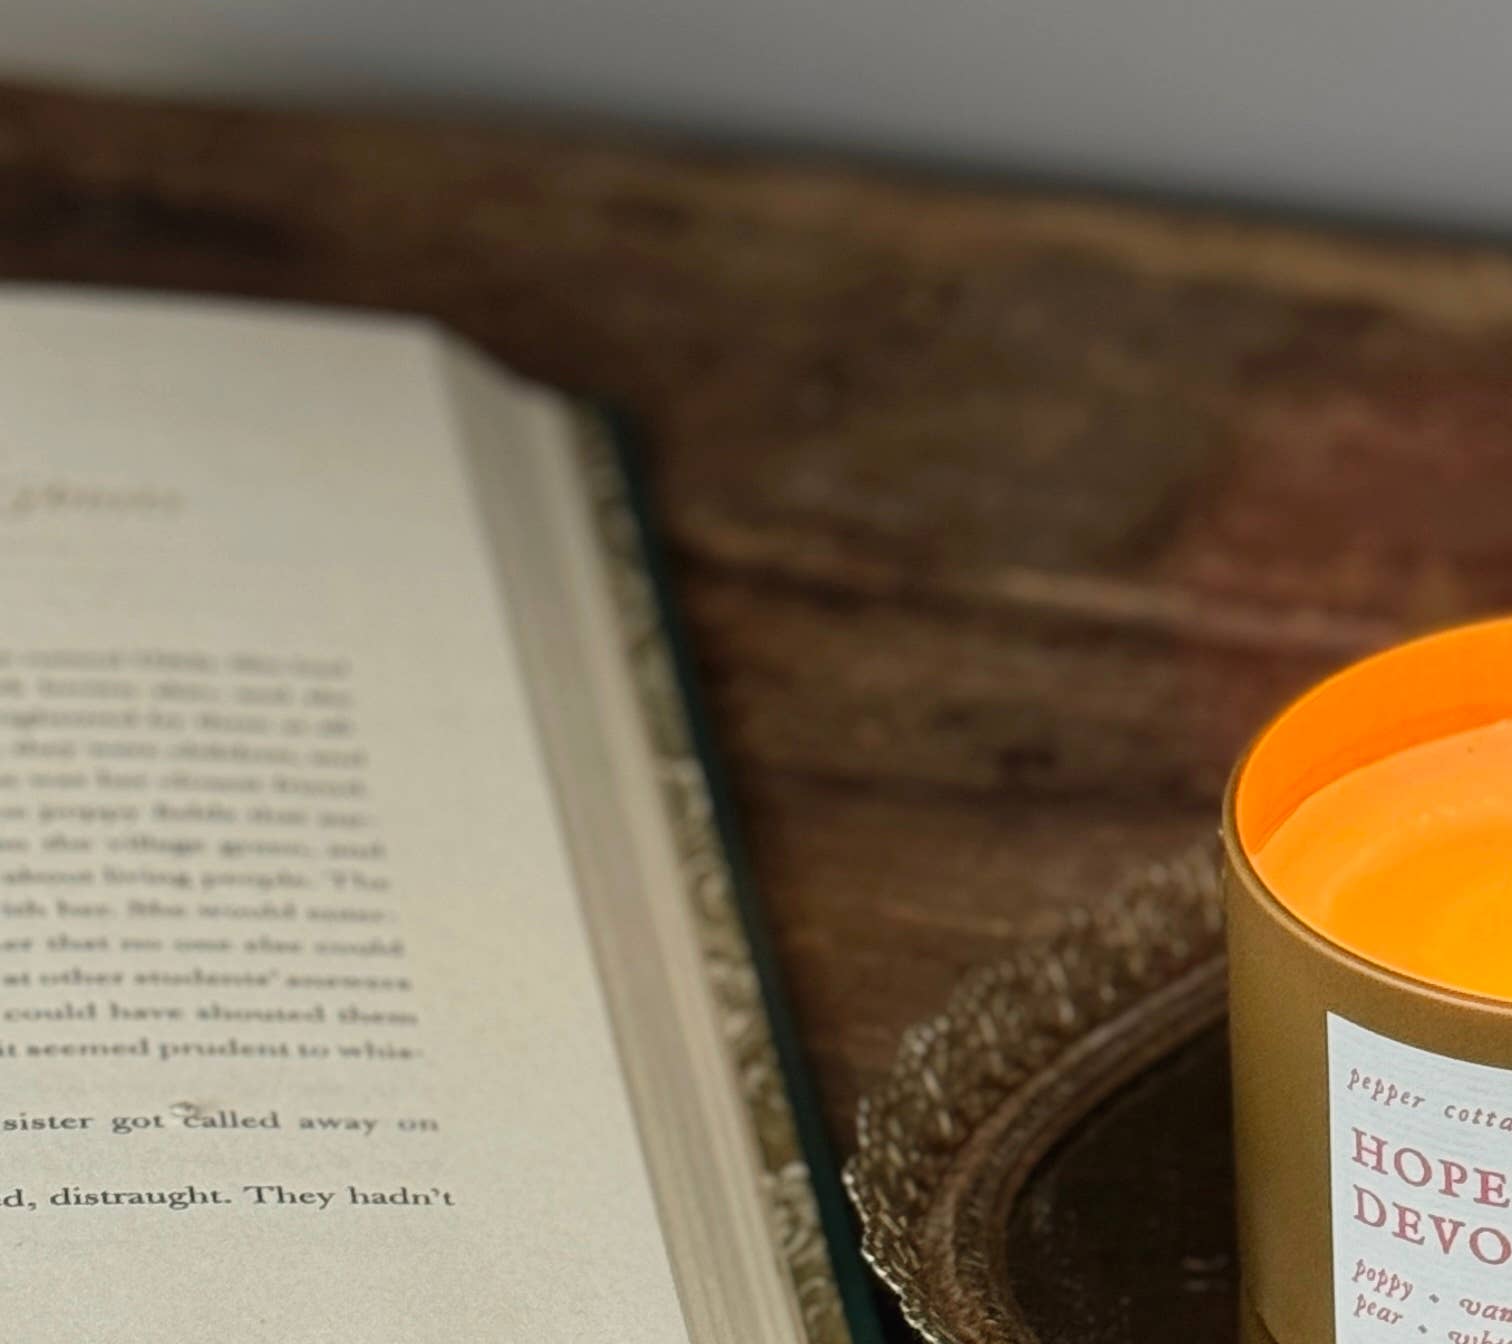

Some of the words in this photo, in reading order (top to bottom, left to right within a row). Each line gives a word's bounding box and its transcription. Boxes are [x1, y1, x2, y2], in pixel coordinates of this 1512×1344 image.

[3, 1001, 96, 1021] could
[110, 1002, 184, 1022] have
[26, 1037, 149, 1058] seemed
[160, 1039, 289, 1061] prudent
[297, 1043, 330, 1060] to
[1347, 1068, 1426, 1109] pepper
[3, 1112, 95, 1131] sister
[112, 1113, 165, 1134] got
[182, 1111, 280, 1129] called
[299, 1119, 378, 1136] away
[397, 1119, 439, 1131] on
[49, 1186, 232, 1210] distraught.
[243, 1185, 336, 1210] They
[348, 1186, 456, 1206] hadn't
[1352, 1258, 1414, 1302] poppy
[1353, 1293, 1403, 1326] pear
